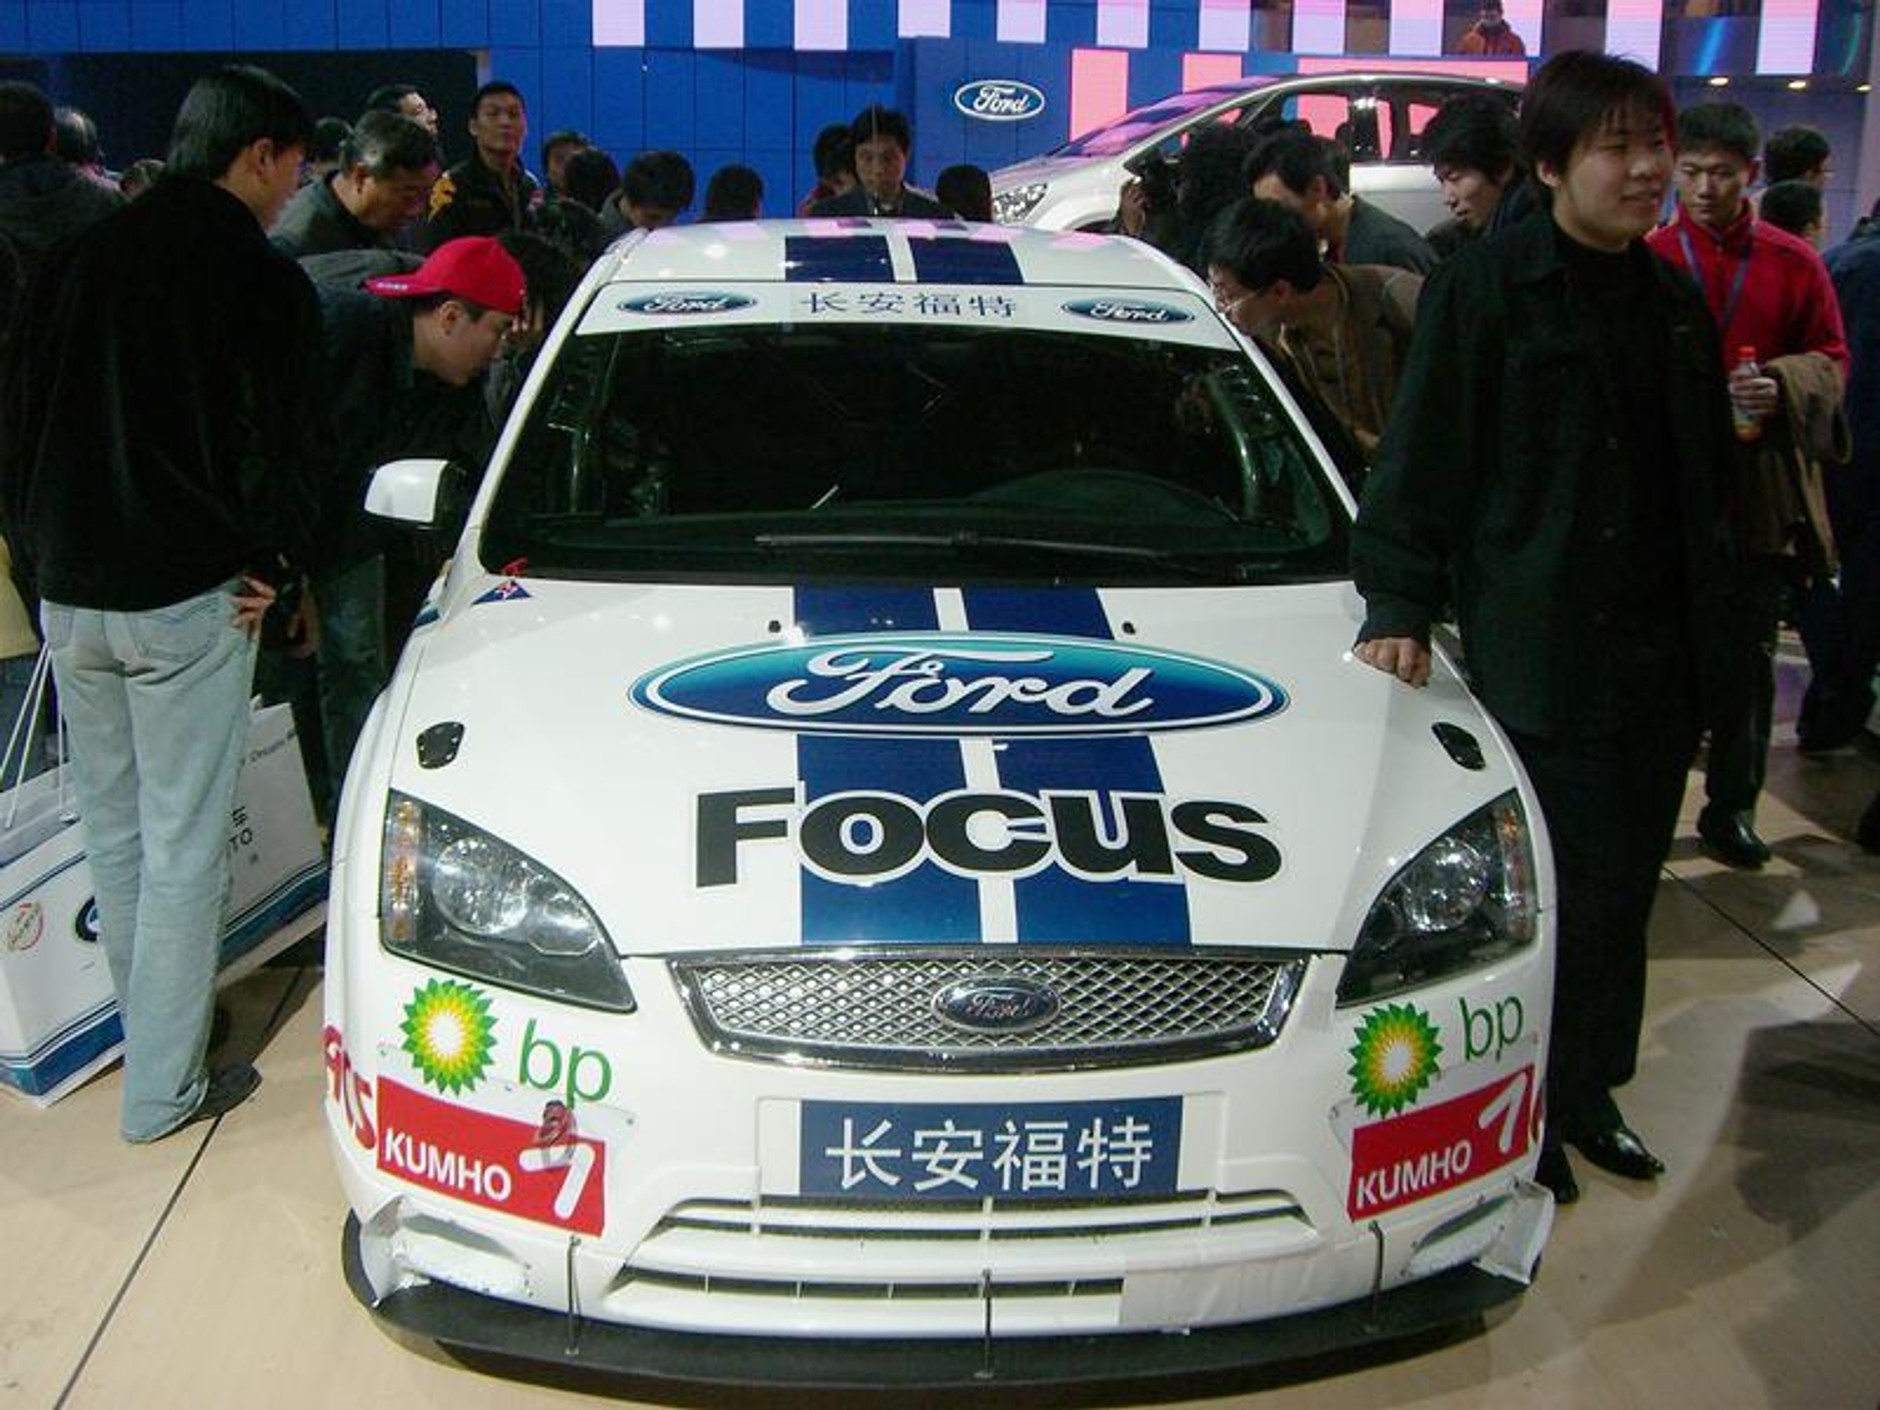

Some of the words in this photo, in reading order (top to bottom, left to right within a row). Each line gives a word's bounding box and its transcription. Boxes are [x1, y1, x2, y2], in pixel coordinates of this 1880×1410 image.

[973, 85, 1028, 112] Ford
[643, 292, 730, 313] Ford
[801, 291, 1017, 318] 长安福特
[1090, 301, 1170, 322] Ford
[766, 645, 1154, 718] Ford
[1459, 996, 1524, 1062] bp
[519, 1018, 613, 1110] bp
[384, 1127, 512, 1201] KUMHO
[824, 1115, 1154, 1192] 长安福特
[1355, 1138, 1473, 1210] KUMHO
